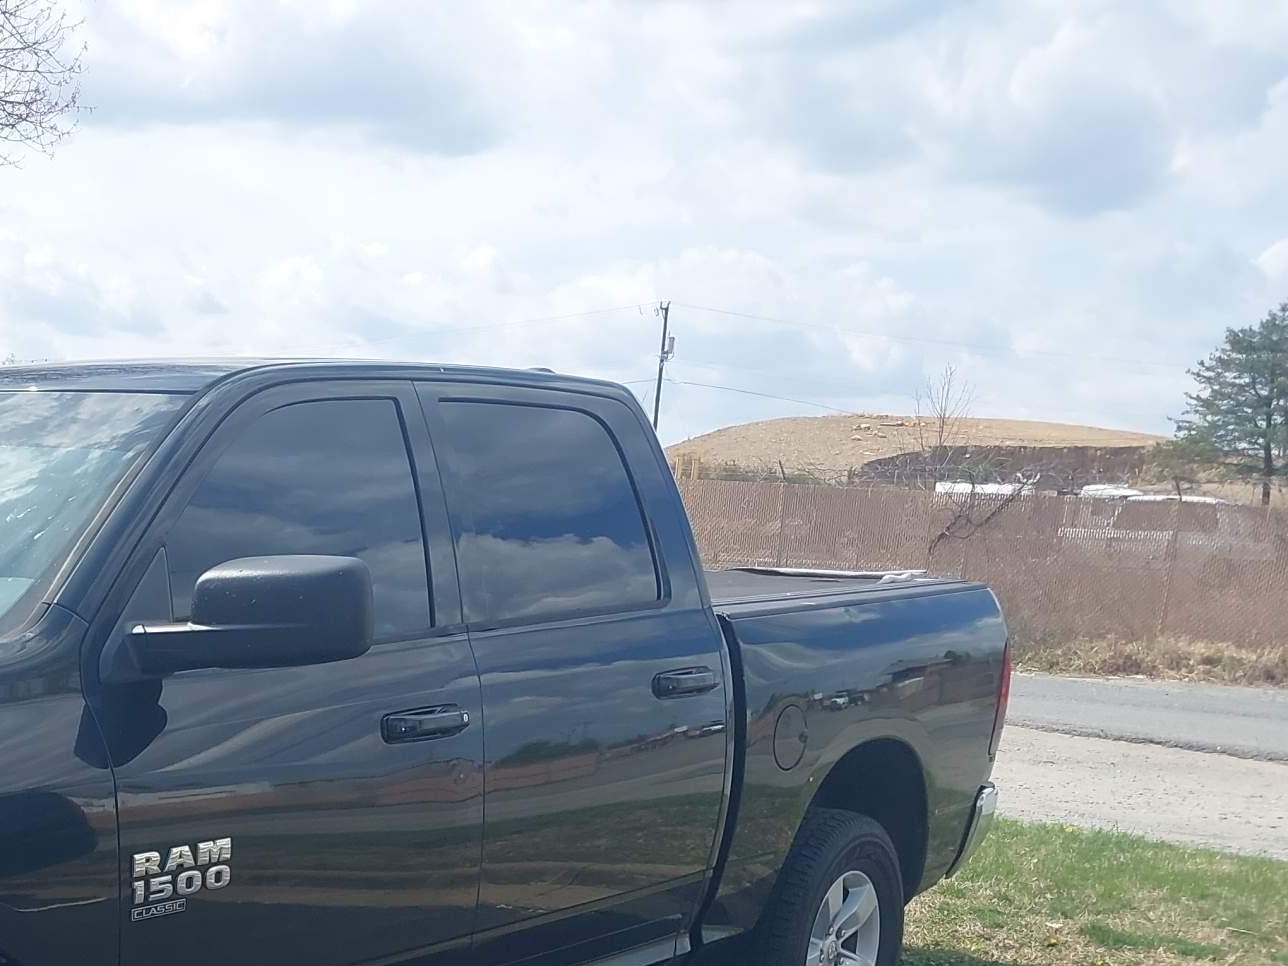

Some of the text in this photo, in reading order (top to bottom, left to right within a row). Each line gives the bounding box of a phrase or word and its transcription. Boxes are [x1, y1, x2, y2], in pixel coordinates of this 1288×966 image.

[132, 837, 232, 878] RAM
[132, 865, 232, 905] 1500
[133, 900, 186, 920] CLASSIC
